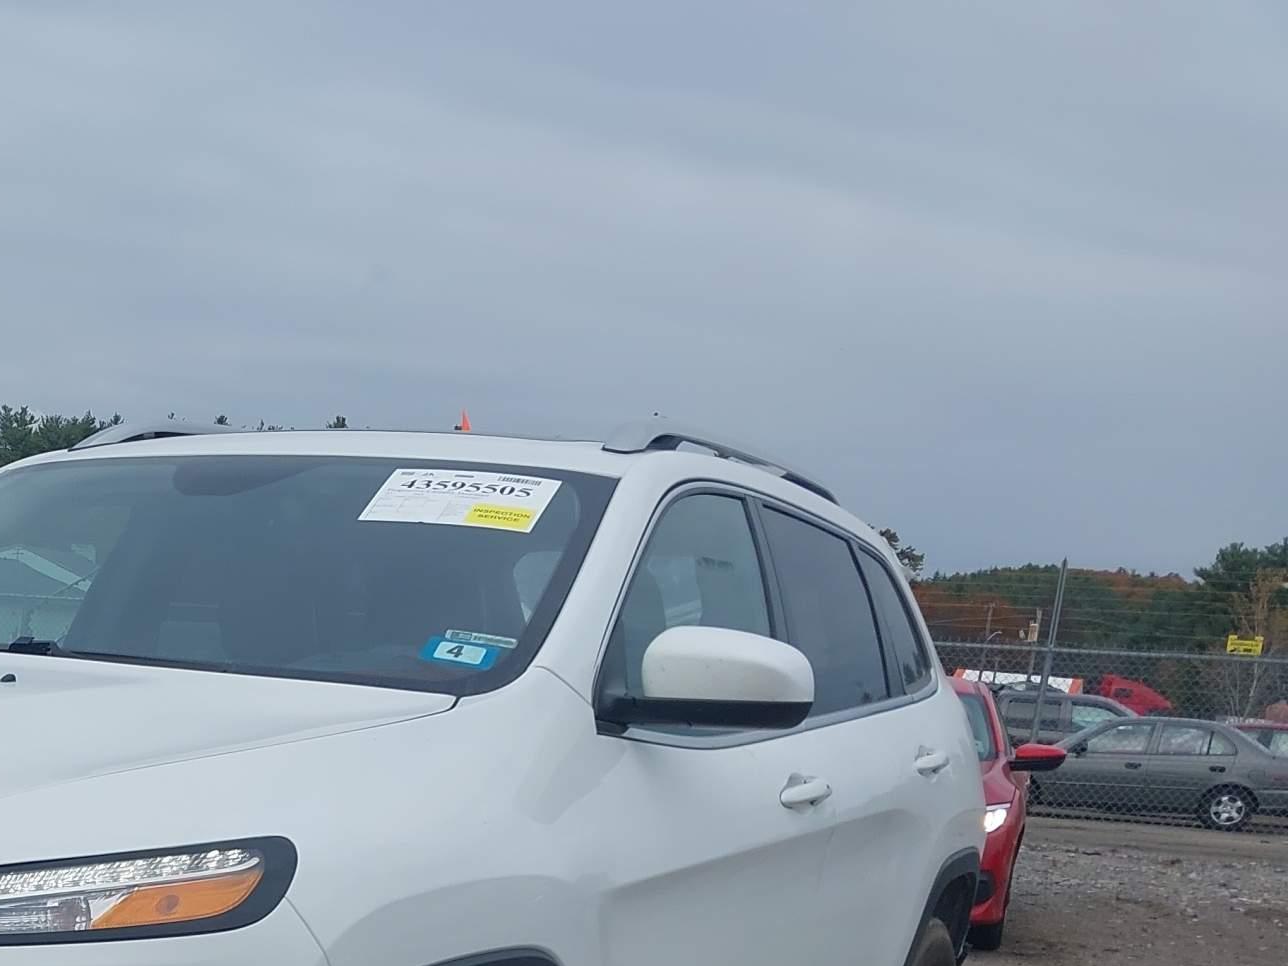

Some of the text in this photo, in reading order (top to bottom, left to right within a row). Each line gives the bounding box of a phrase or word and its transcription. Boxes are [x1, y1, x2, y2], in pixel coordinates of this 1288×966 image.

[400, 479, 534, 498] 43595505
[473, 508, 531, 519] INSPECTION
[477, 513, 520, 523] SERVICE
[446, 645, 464, 658] 4
